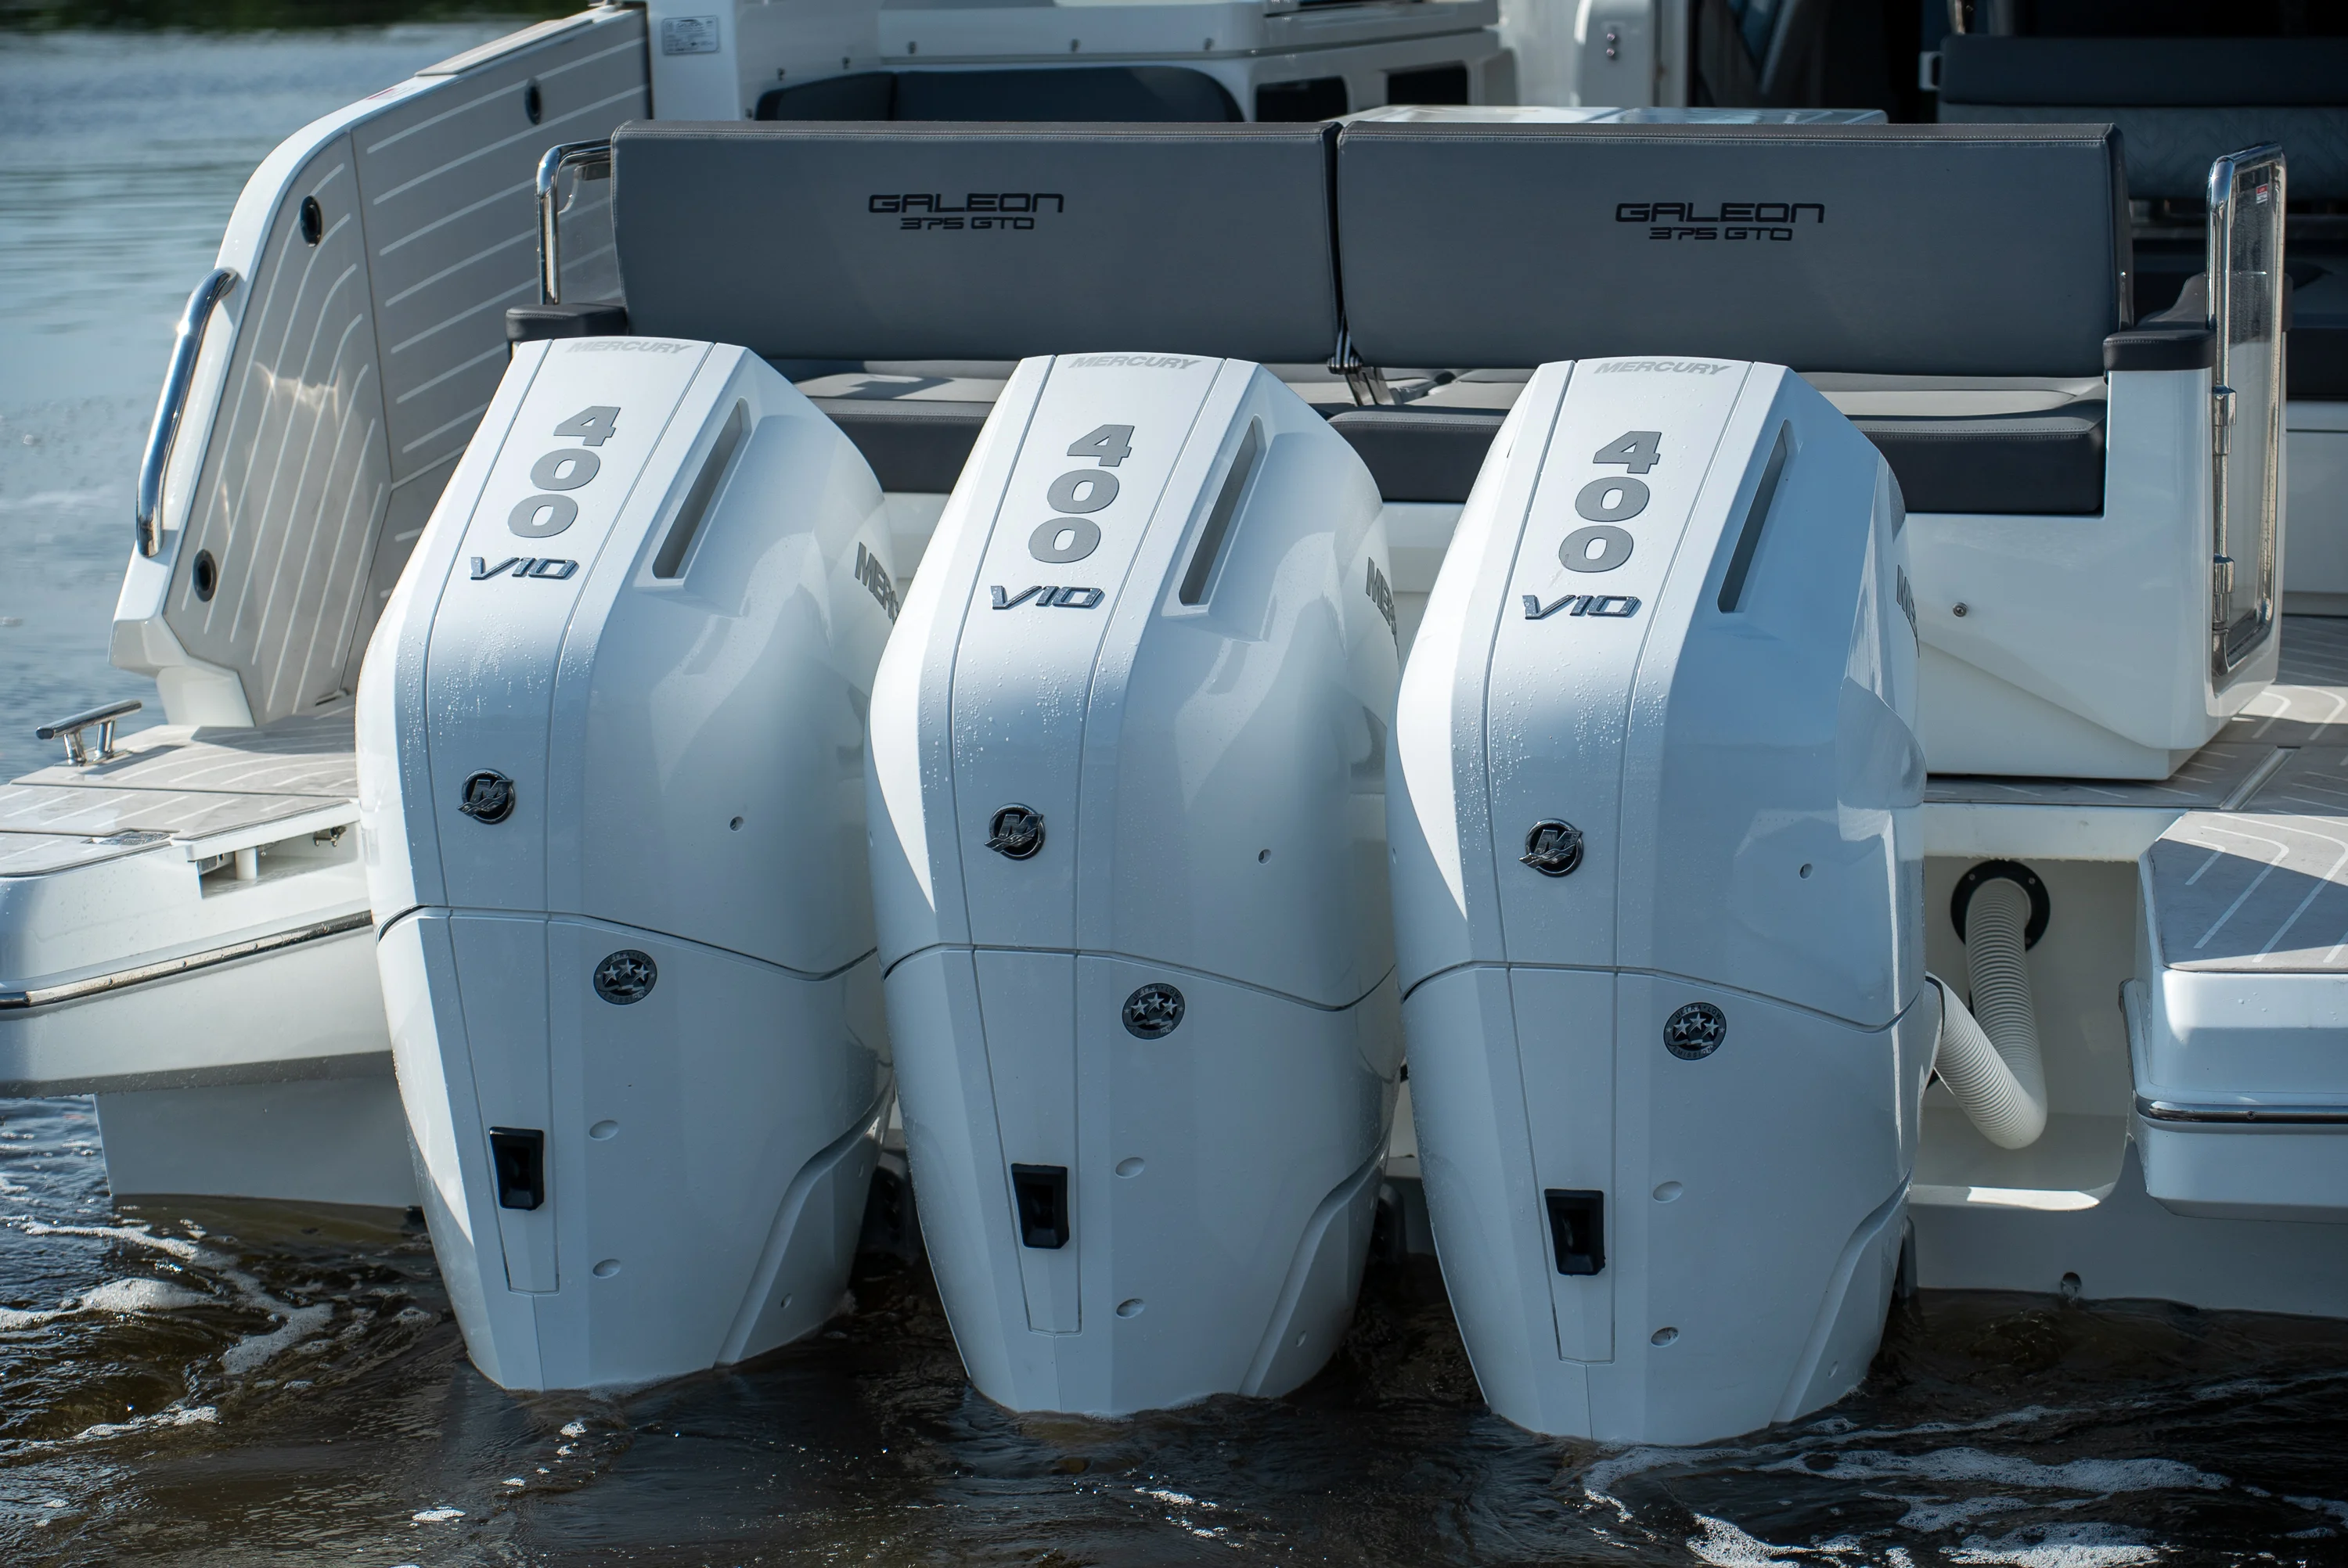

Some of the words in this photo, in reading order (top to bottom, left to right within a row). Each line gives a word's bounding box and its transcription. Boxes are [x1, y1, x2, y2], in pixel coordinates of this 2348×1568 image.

[868, 192, 1064, 214] GALEON
[1615, 202, 1825, 224] GALEON
[900, 217, 964, 230] 375
[971, 216, 1035, 230] GTO
[1649, 226, 1718, 240] 375
[1724, 226, 1793, 241] GTO
[565, 340, 693, 354] MERCURY
[1068, 355, 1201, 369] MERCURY
[1594, 361, 1733, 376] MERCURY
[470, 556, 579, 580] V10
[989, 585, 1104, 610] V10
[1522, 594, 1642, 620] V10
[1707, 1006, 1723, 1020] LOW
